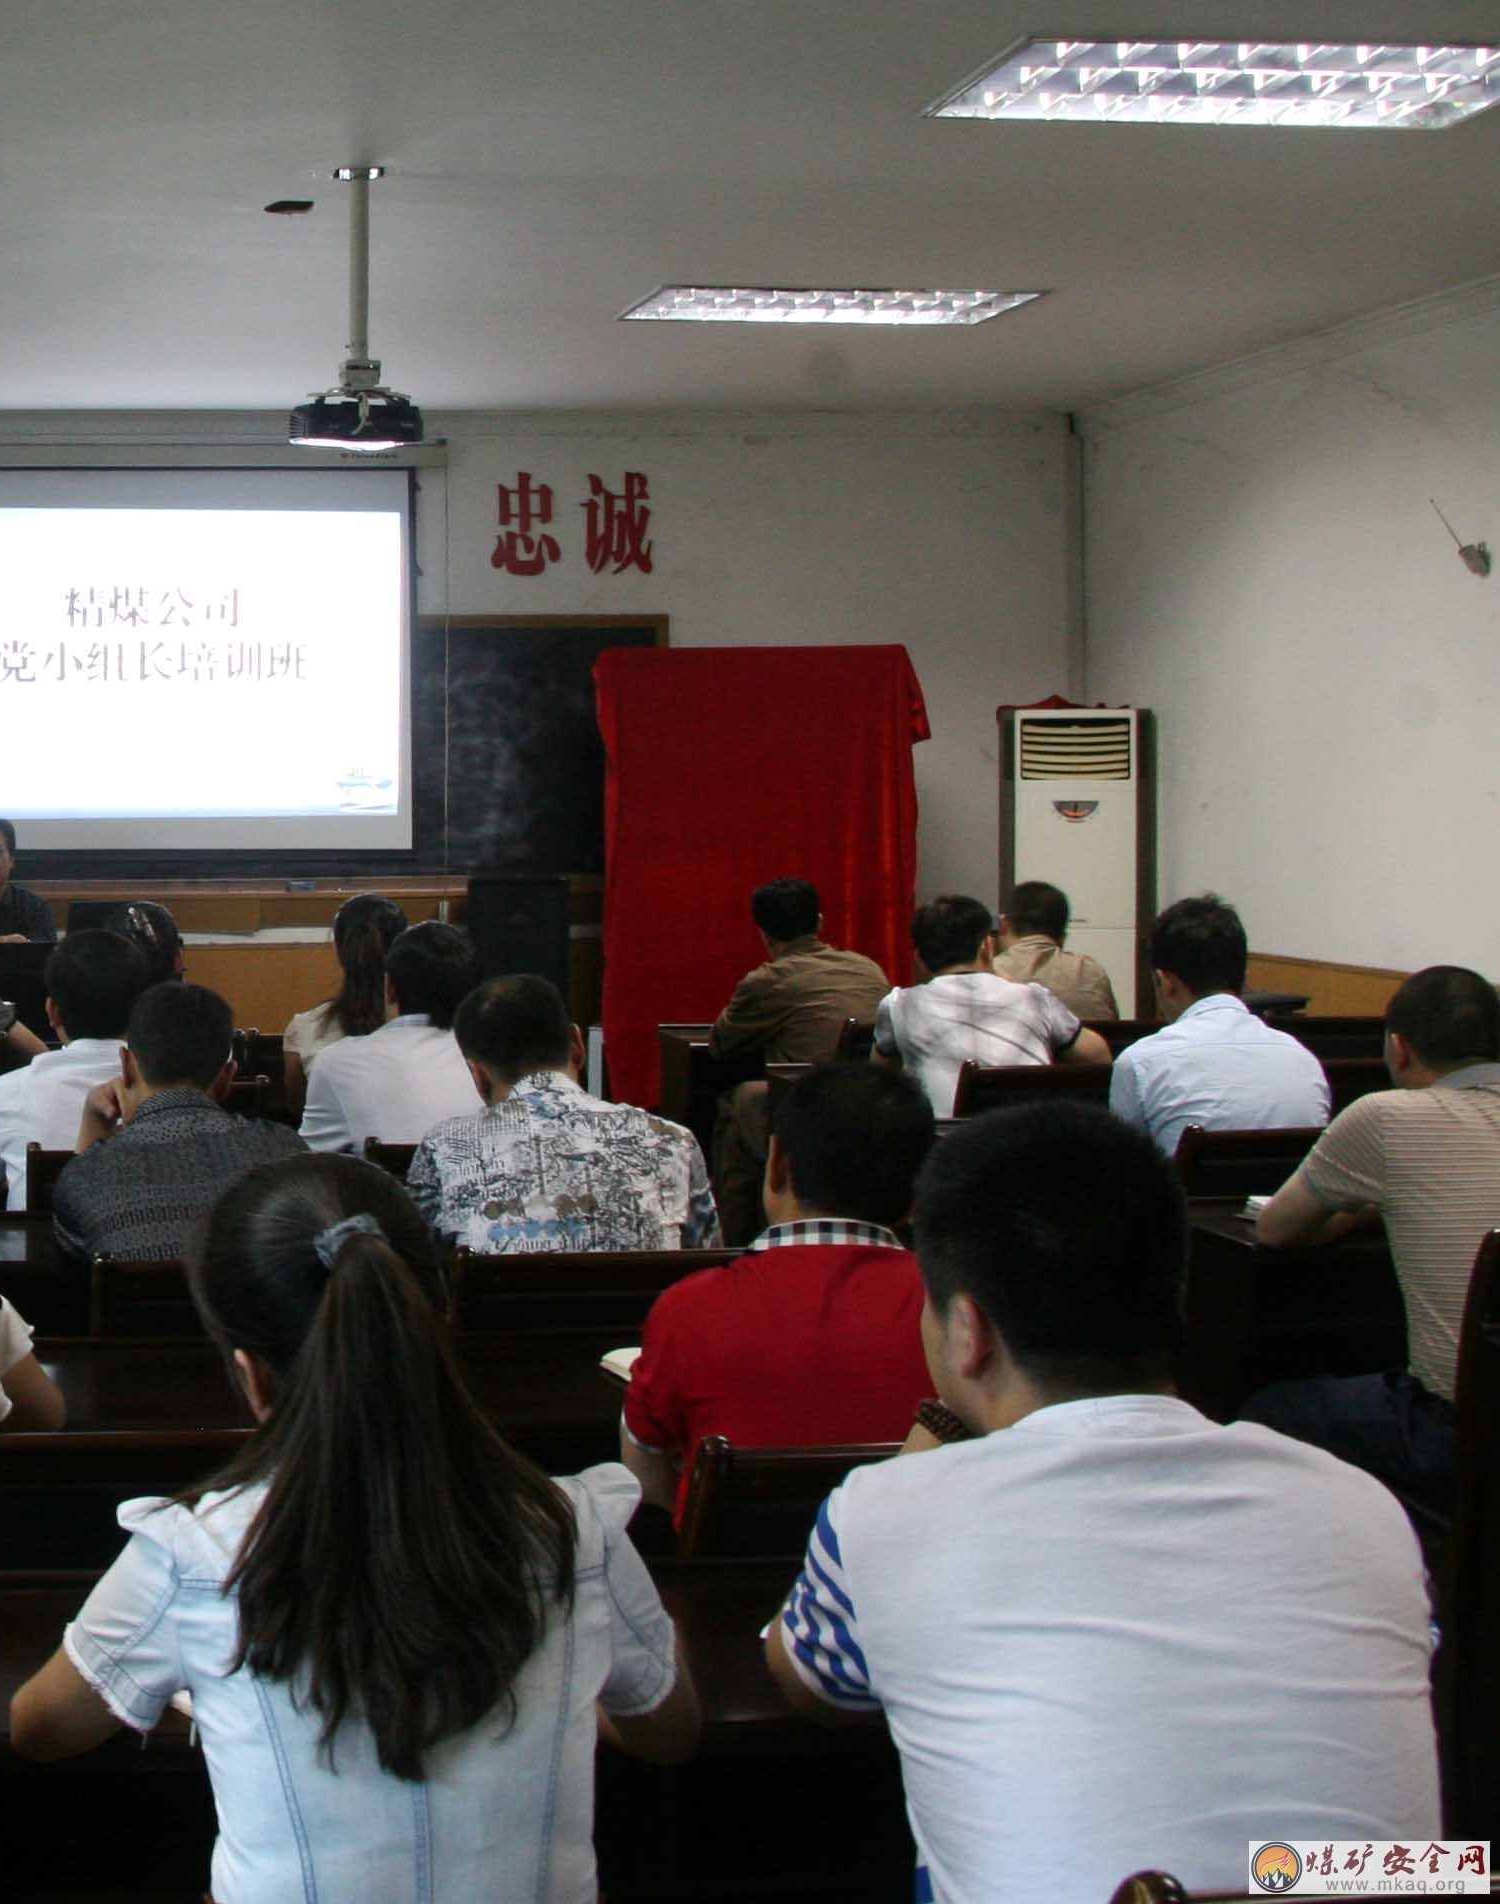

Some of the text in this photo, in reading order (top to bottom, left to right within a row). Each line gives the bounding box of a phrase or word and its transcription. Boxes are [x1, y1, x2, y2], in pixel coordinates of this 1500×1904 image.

[491, 471, 653, 577] 忠诚
[64, 586, 239, 628] 精煤公司
